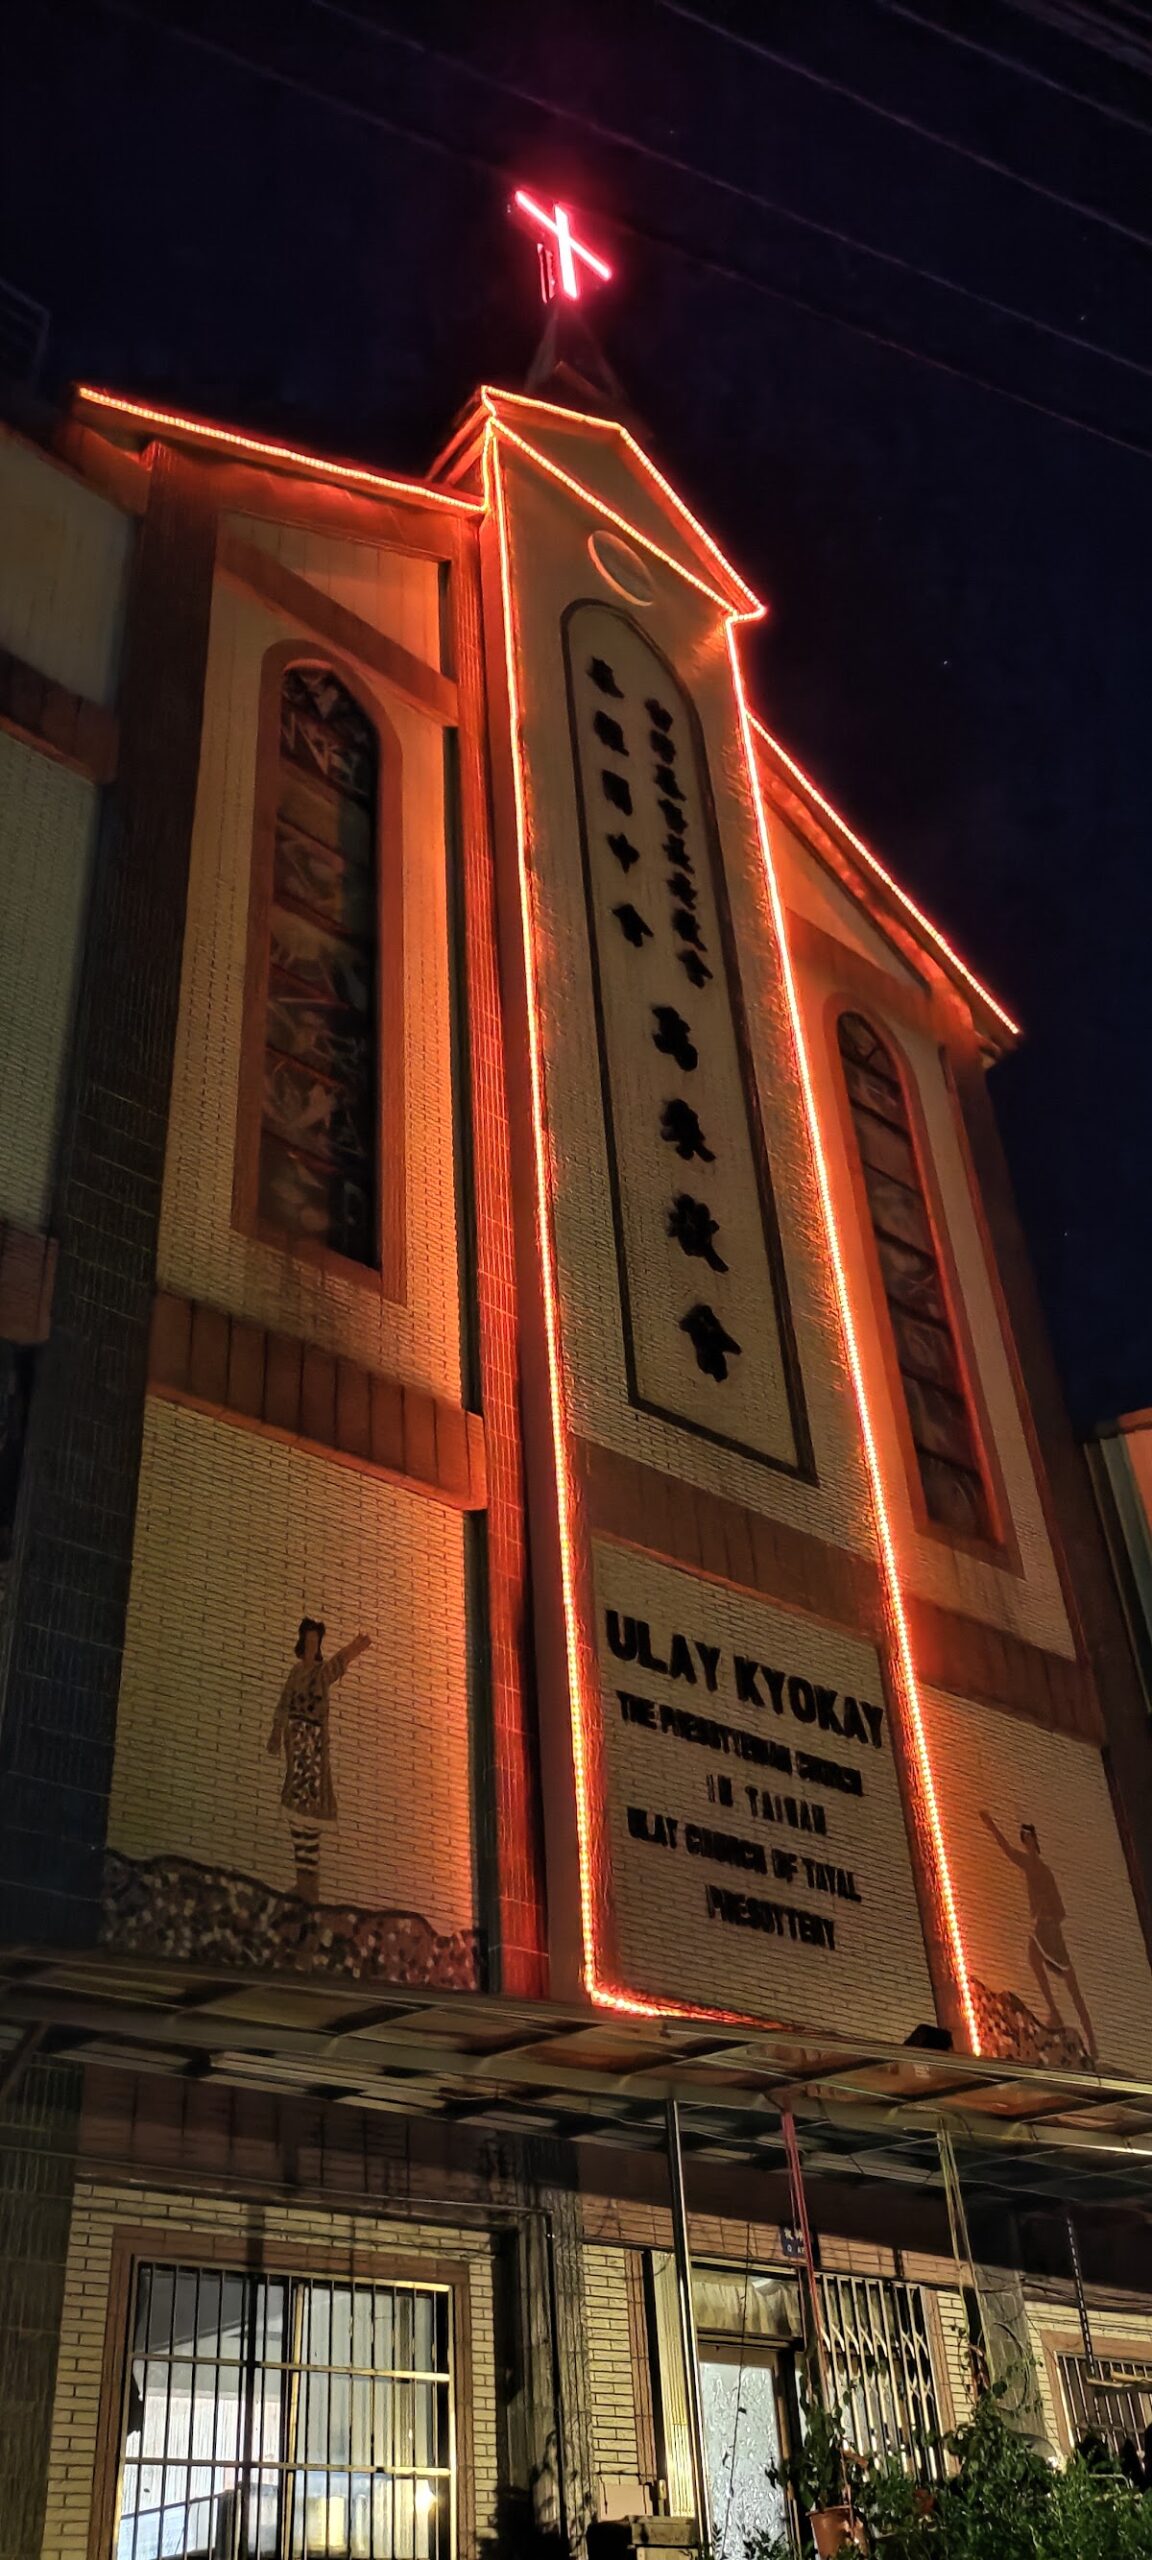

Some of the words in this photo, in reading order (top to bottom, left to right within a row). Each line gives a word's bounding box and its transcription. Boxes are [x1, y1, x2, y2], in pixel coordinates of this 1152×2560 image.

[606, 1609, 720, 1692] ULAY
[734, 1655, 883, 1749] KYOKAY
[616, 1690, 656, 1730] THE
[706, 1774, 733, 1807] IN
[745, 1786, 827, 1836] TAIWAN
[627, 1807, 678, 1849] ULAY
[684, 1823, 767, 1875] CHURCH
[771, 1848, 798, 1882] OF
[802, 1857, 861, 1902] TAYAL
